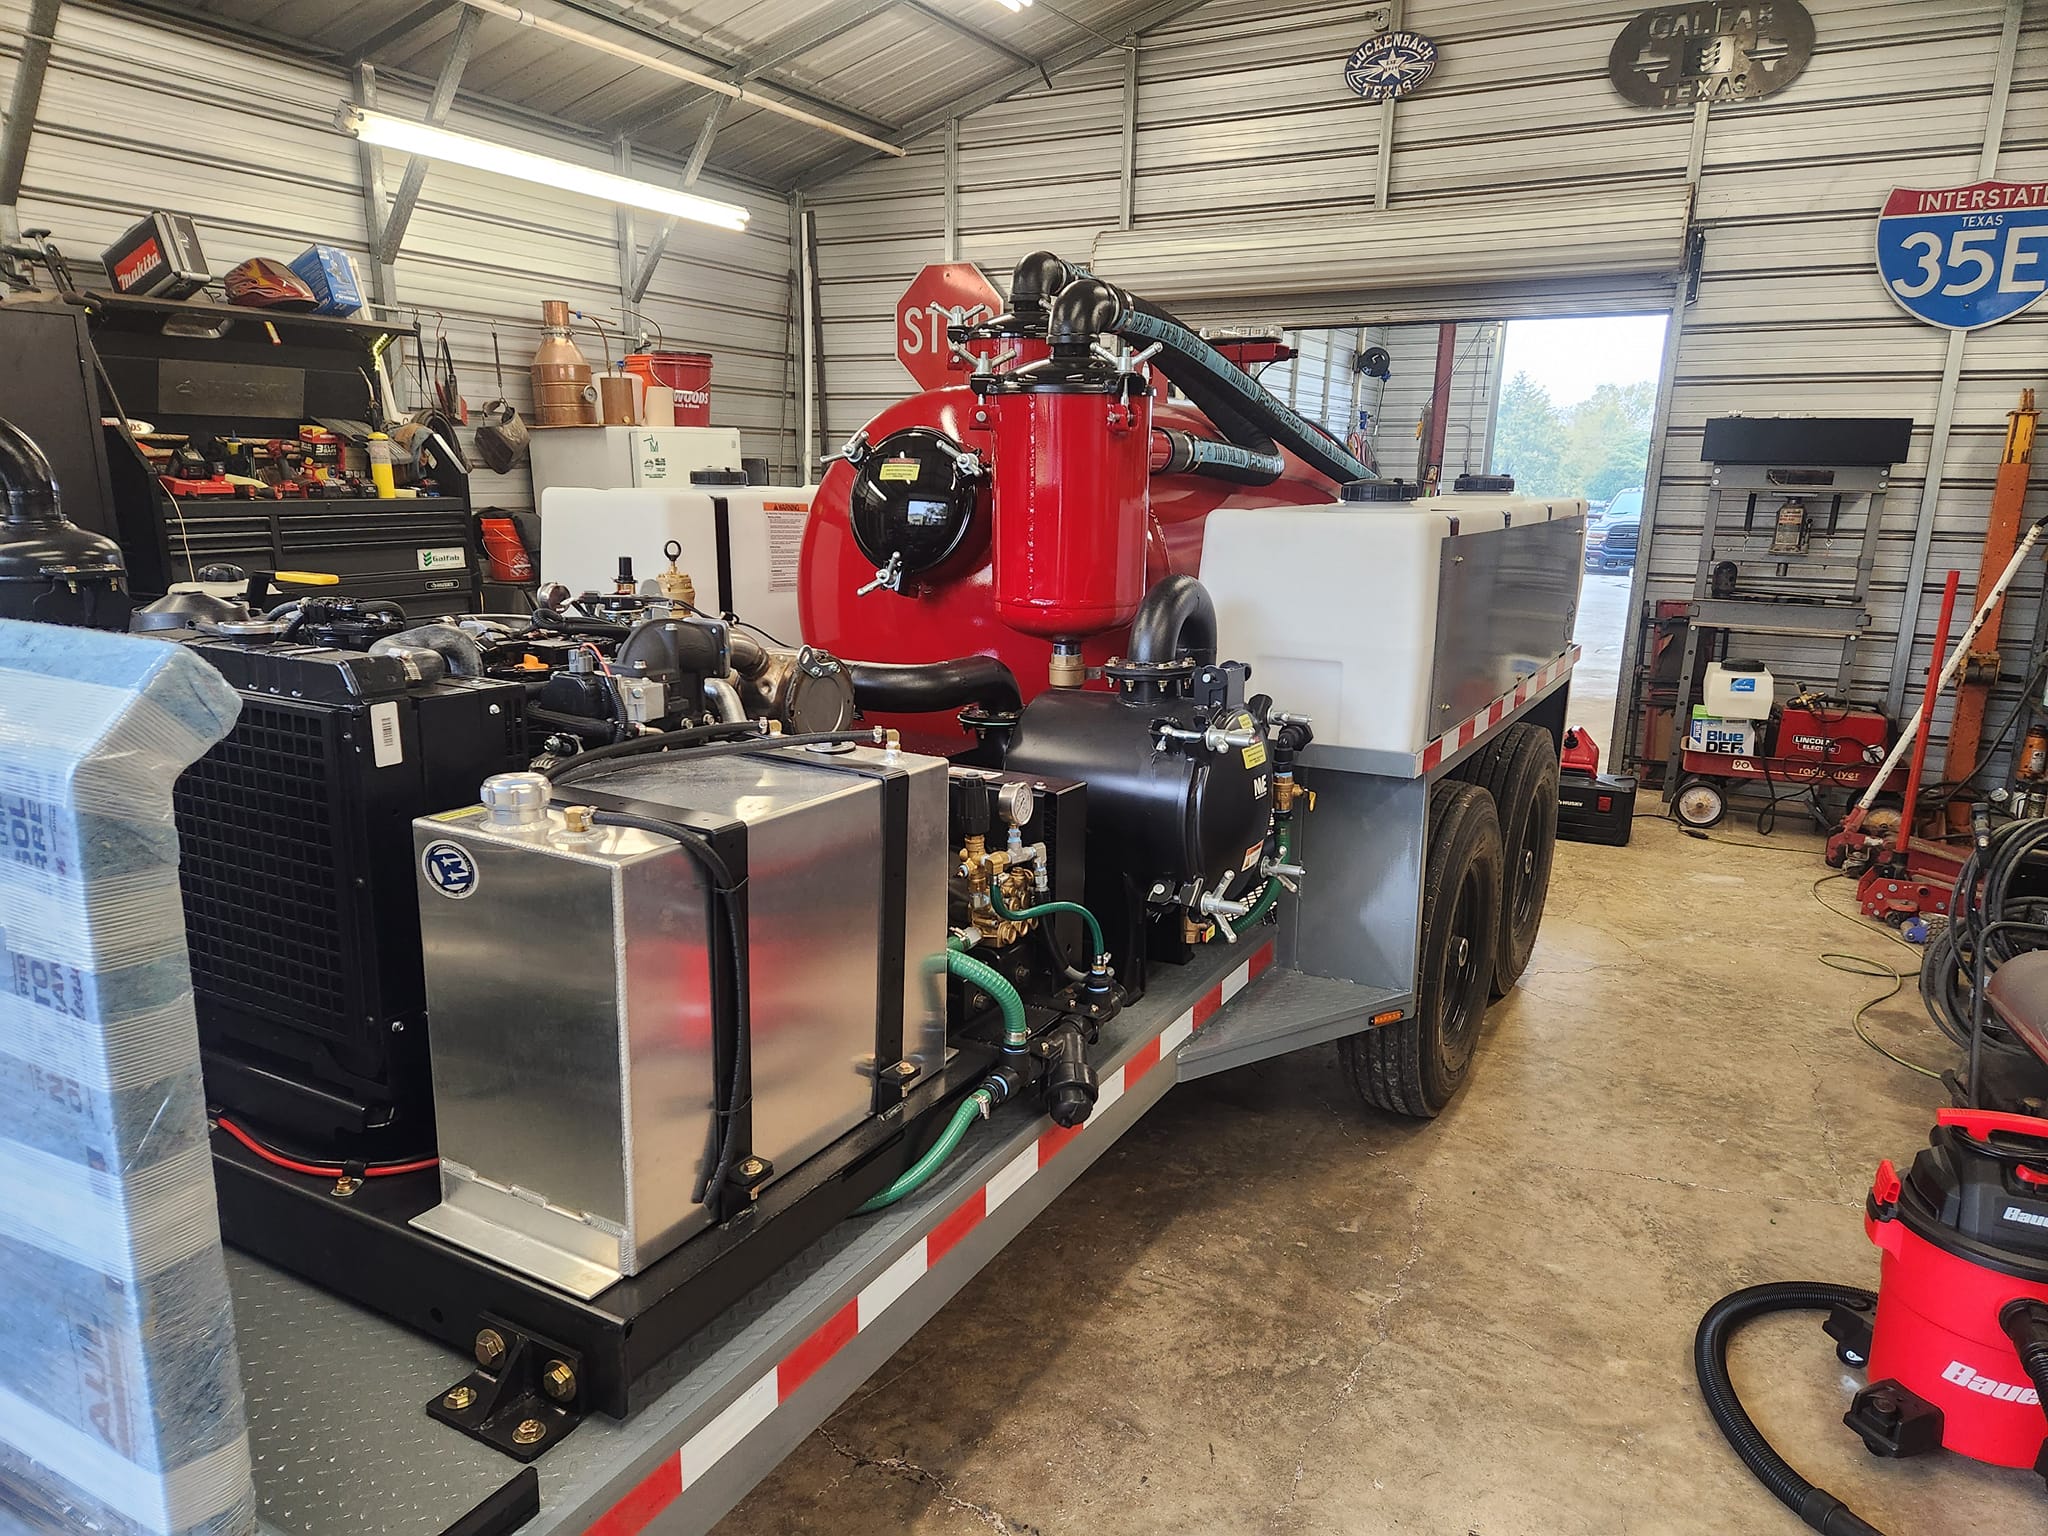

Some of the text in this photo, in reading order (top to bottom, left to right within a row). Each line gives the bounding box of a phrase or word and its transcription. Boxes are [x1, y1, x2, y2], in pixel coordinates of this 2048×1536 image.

[1349, 33, 1434, 70] LUCKENBACH
[1363, 79, 1412, 99] TEXAS
[1660, 74, 1747, 101] TEXAS
[1961, 215, 2004, 228] TEXAS
[1891, 225, 2048, 298] 35E
[777, 503, 800, 511] WARNING
[432, 554, 460, 562] Galfab
[1706, 730, 1744, 742] Blue
[1795, 736, 1835, 746] LINCOLN
[1705, 741, 1744, 753] DEF
[1802, 745, 1836, 753] ELECTIC
[1734, 760, 1750, 769] 90
[1941, 1360, 2042, 1405] Baue
